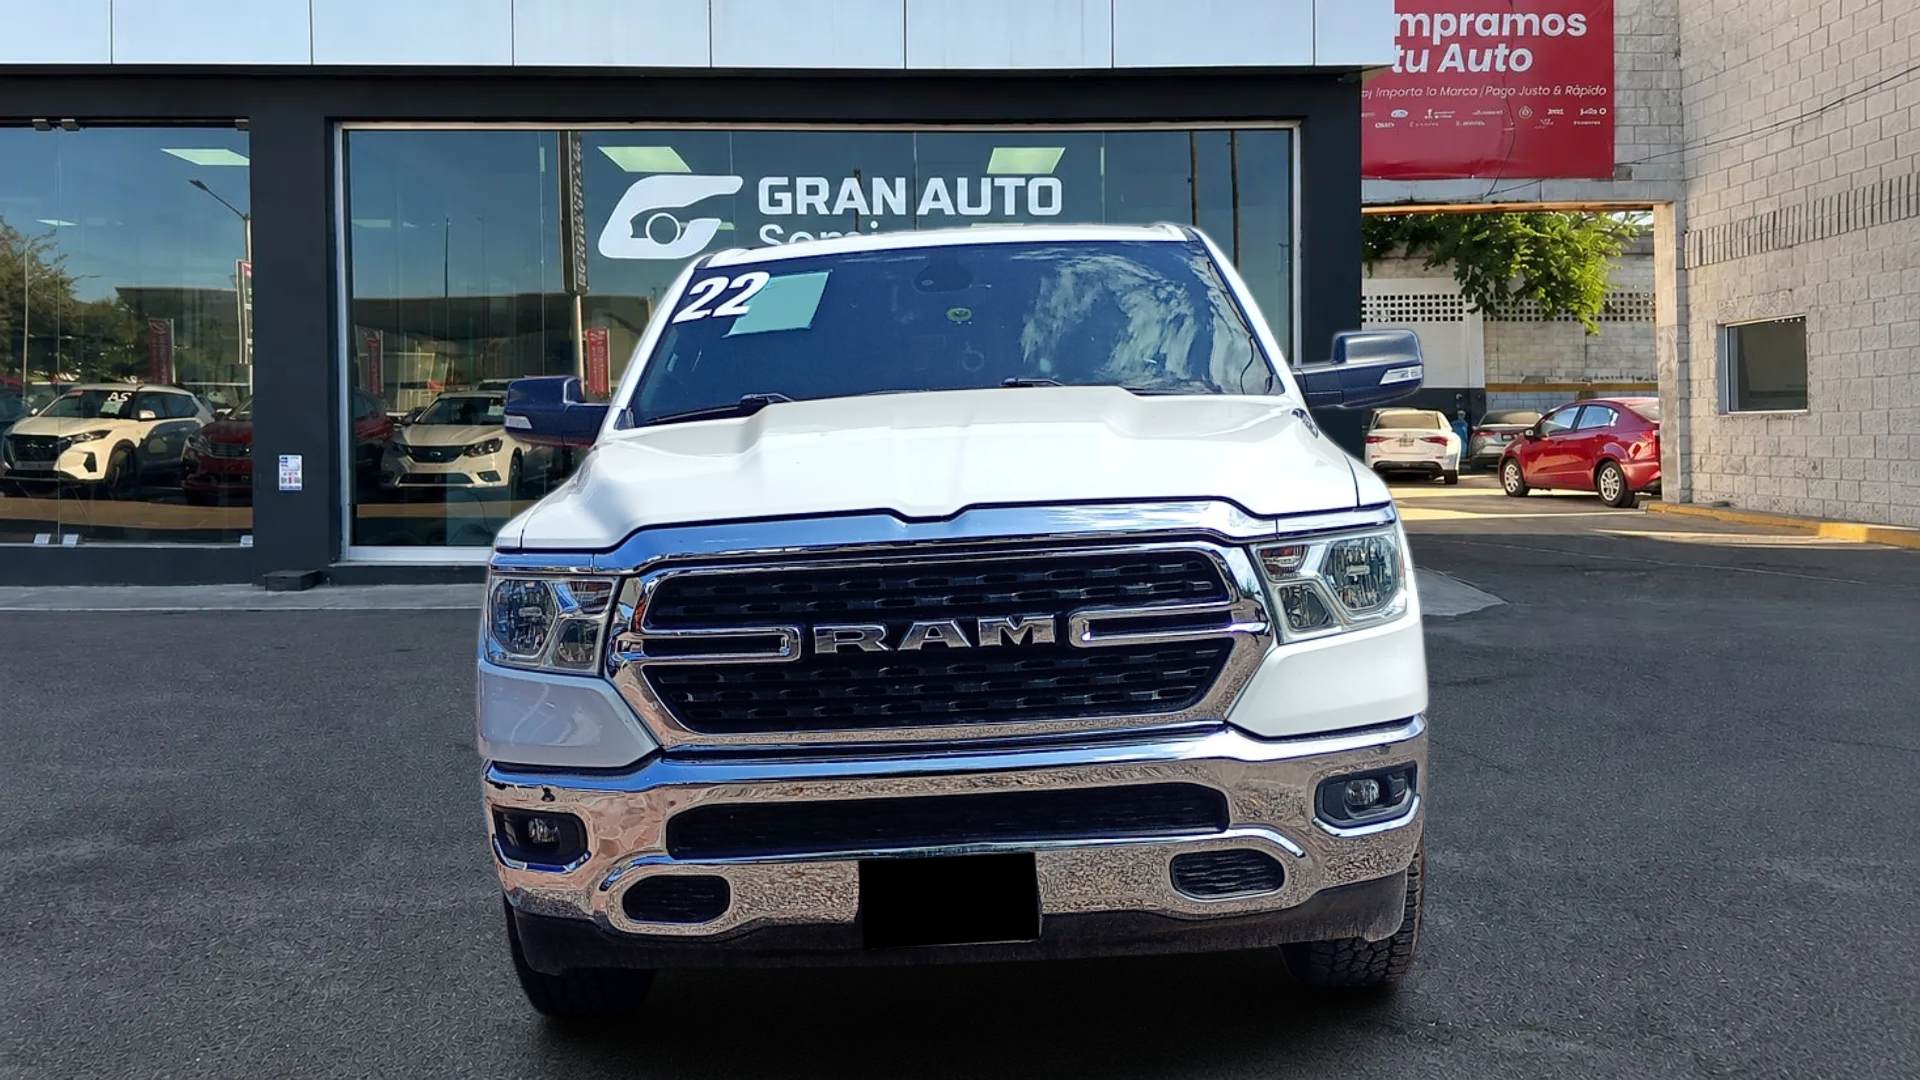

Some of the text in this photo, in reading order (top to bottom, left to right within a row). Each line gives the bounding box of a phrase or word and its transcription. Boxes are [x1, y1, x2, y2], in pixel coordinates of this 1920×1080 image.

[1392, 43, 1533, 73] tu Auto
[1375, 87, 1423, 99] Importa
[1426, 86, 1437, 96] la
[1440, 86, 1478, 96] Marca
[1519, 86, 1551, 96] Justo
[1553, 86, 1561, 96] &
[1565, 84, 1607, 98] Rápido
[758, 176, 1063, 216] GRAN AUTO
[672, 271, 770, 324] 22
[813, 613, 1057, 655] RAM
